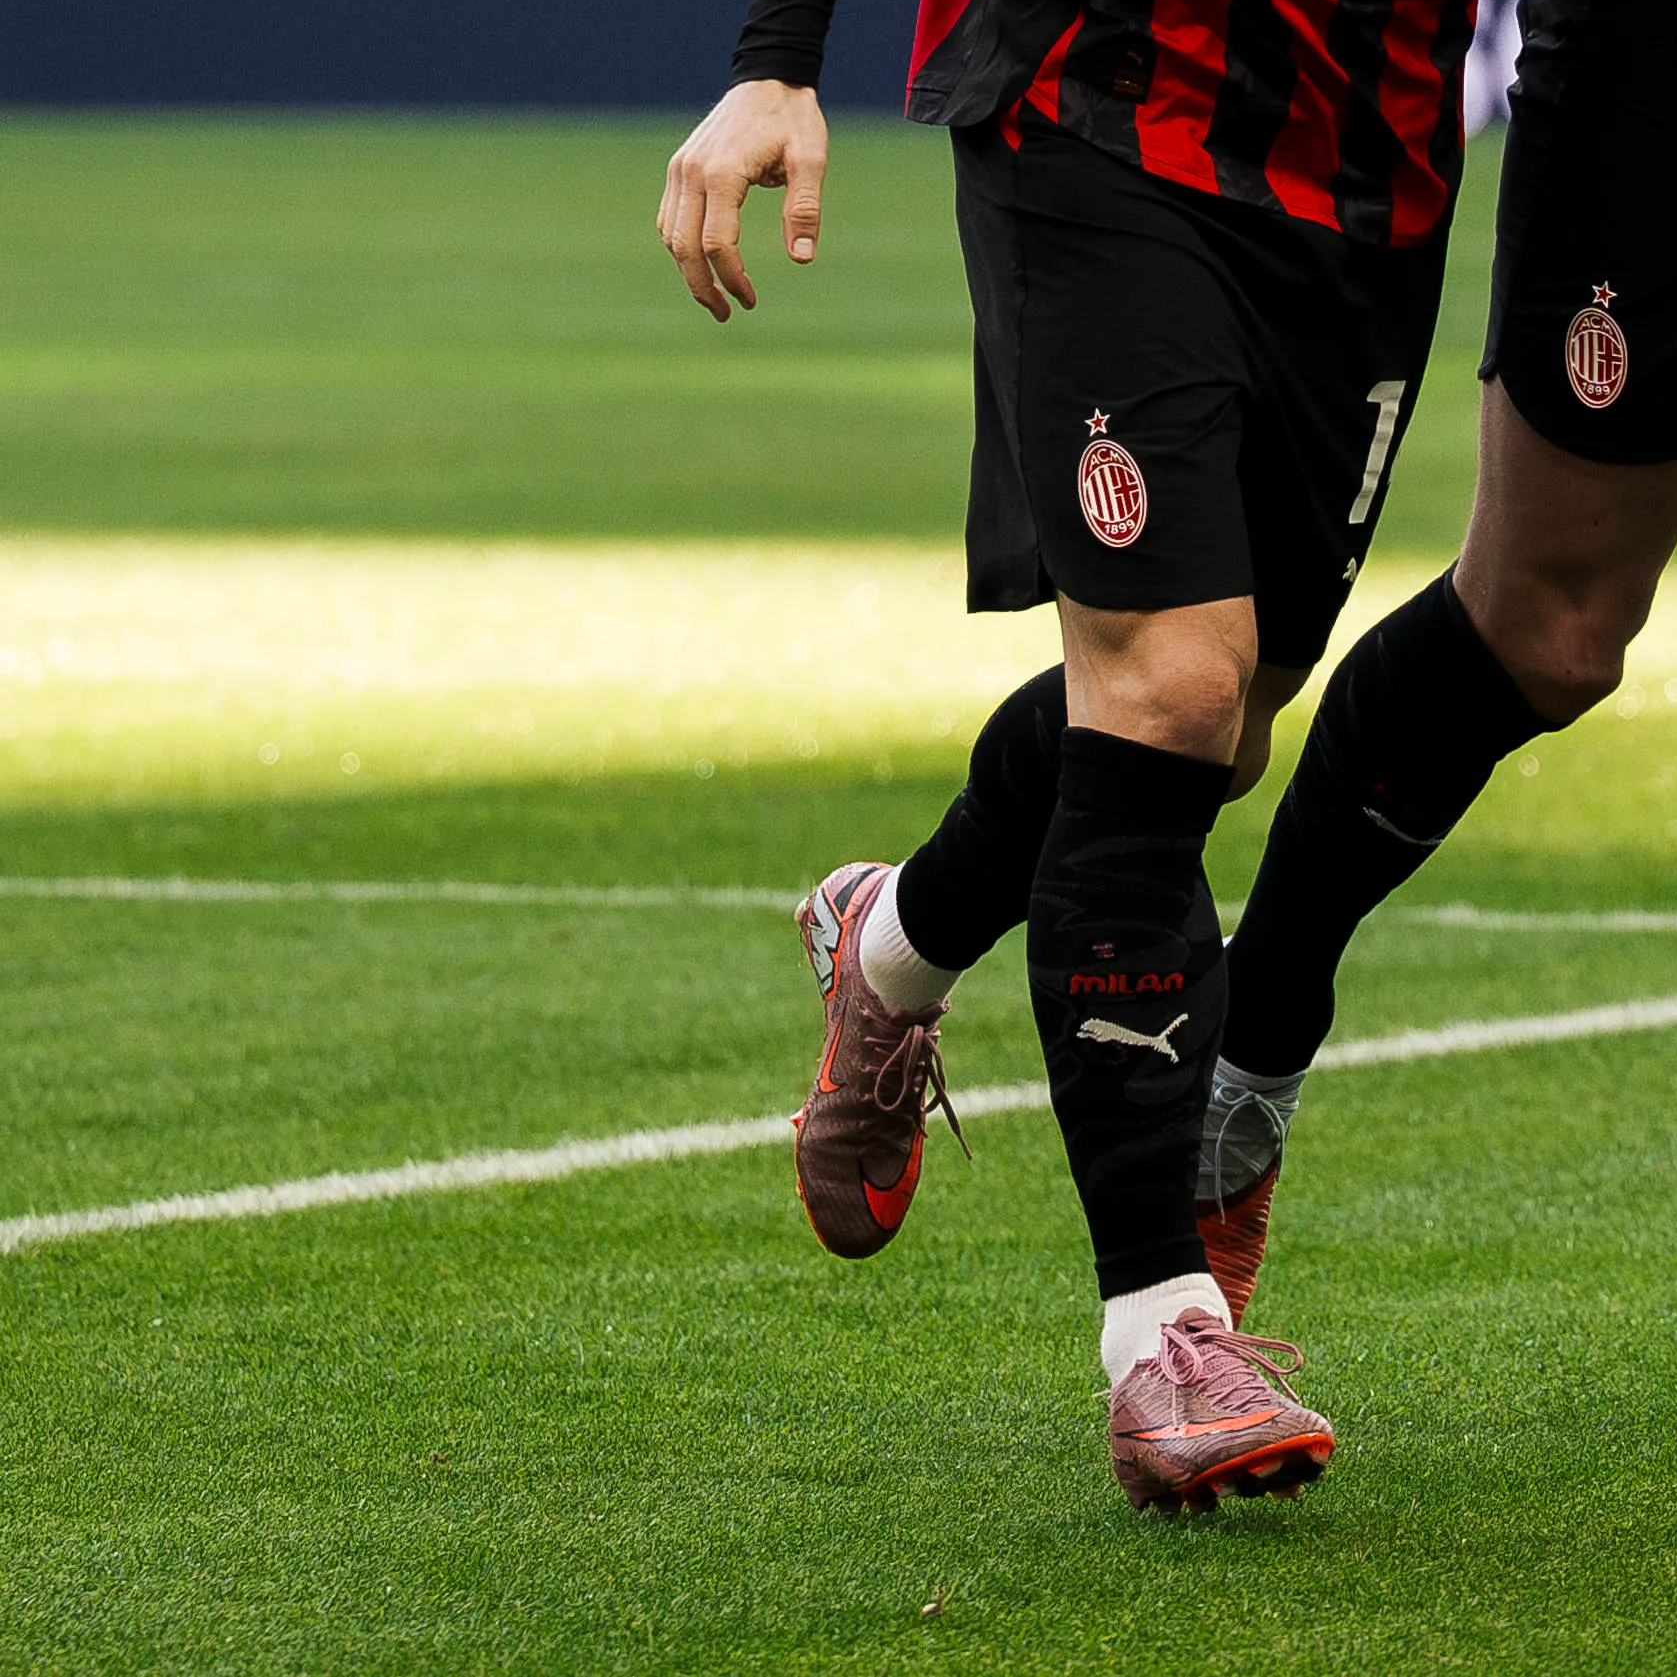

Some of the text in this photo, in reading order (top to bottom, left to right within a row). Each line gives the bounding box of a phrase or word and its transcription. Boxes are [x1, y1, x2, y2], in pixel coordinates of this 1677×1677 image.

[1580, 316, 1613, 335] ACM
[1582, 382, 1611, 396] 1899
[1089, 448, 1123, 471] ACM
[1104, 519, 1136, 535] 1899
